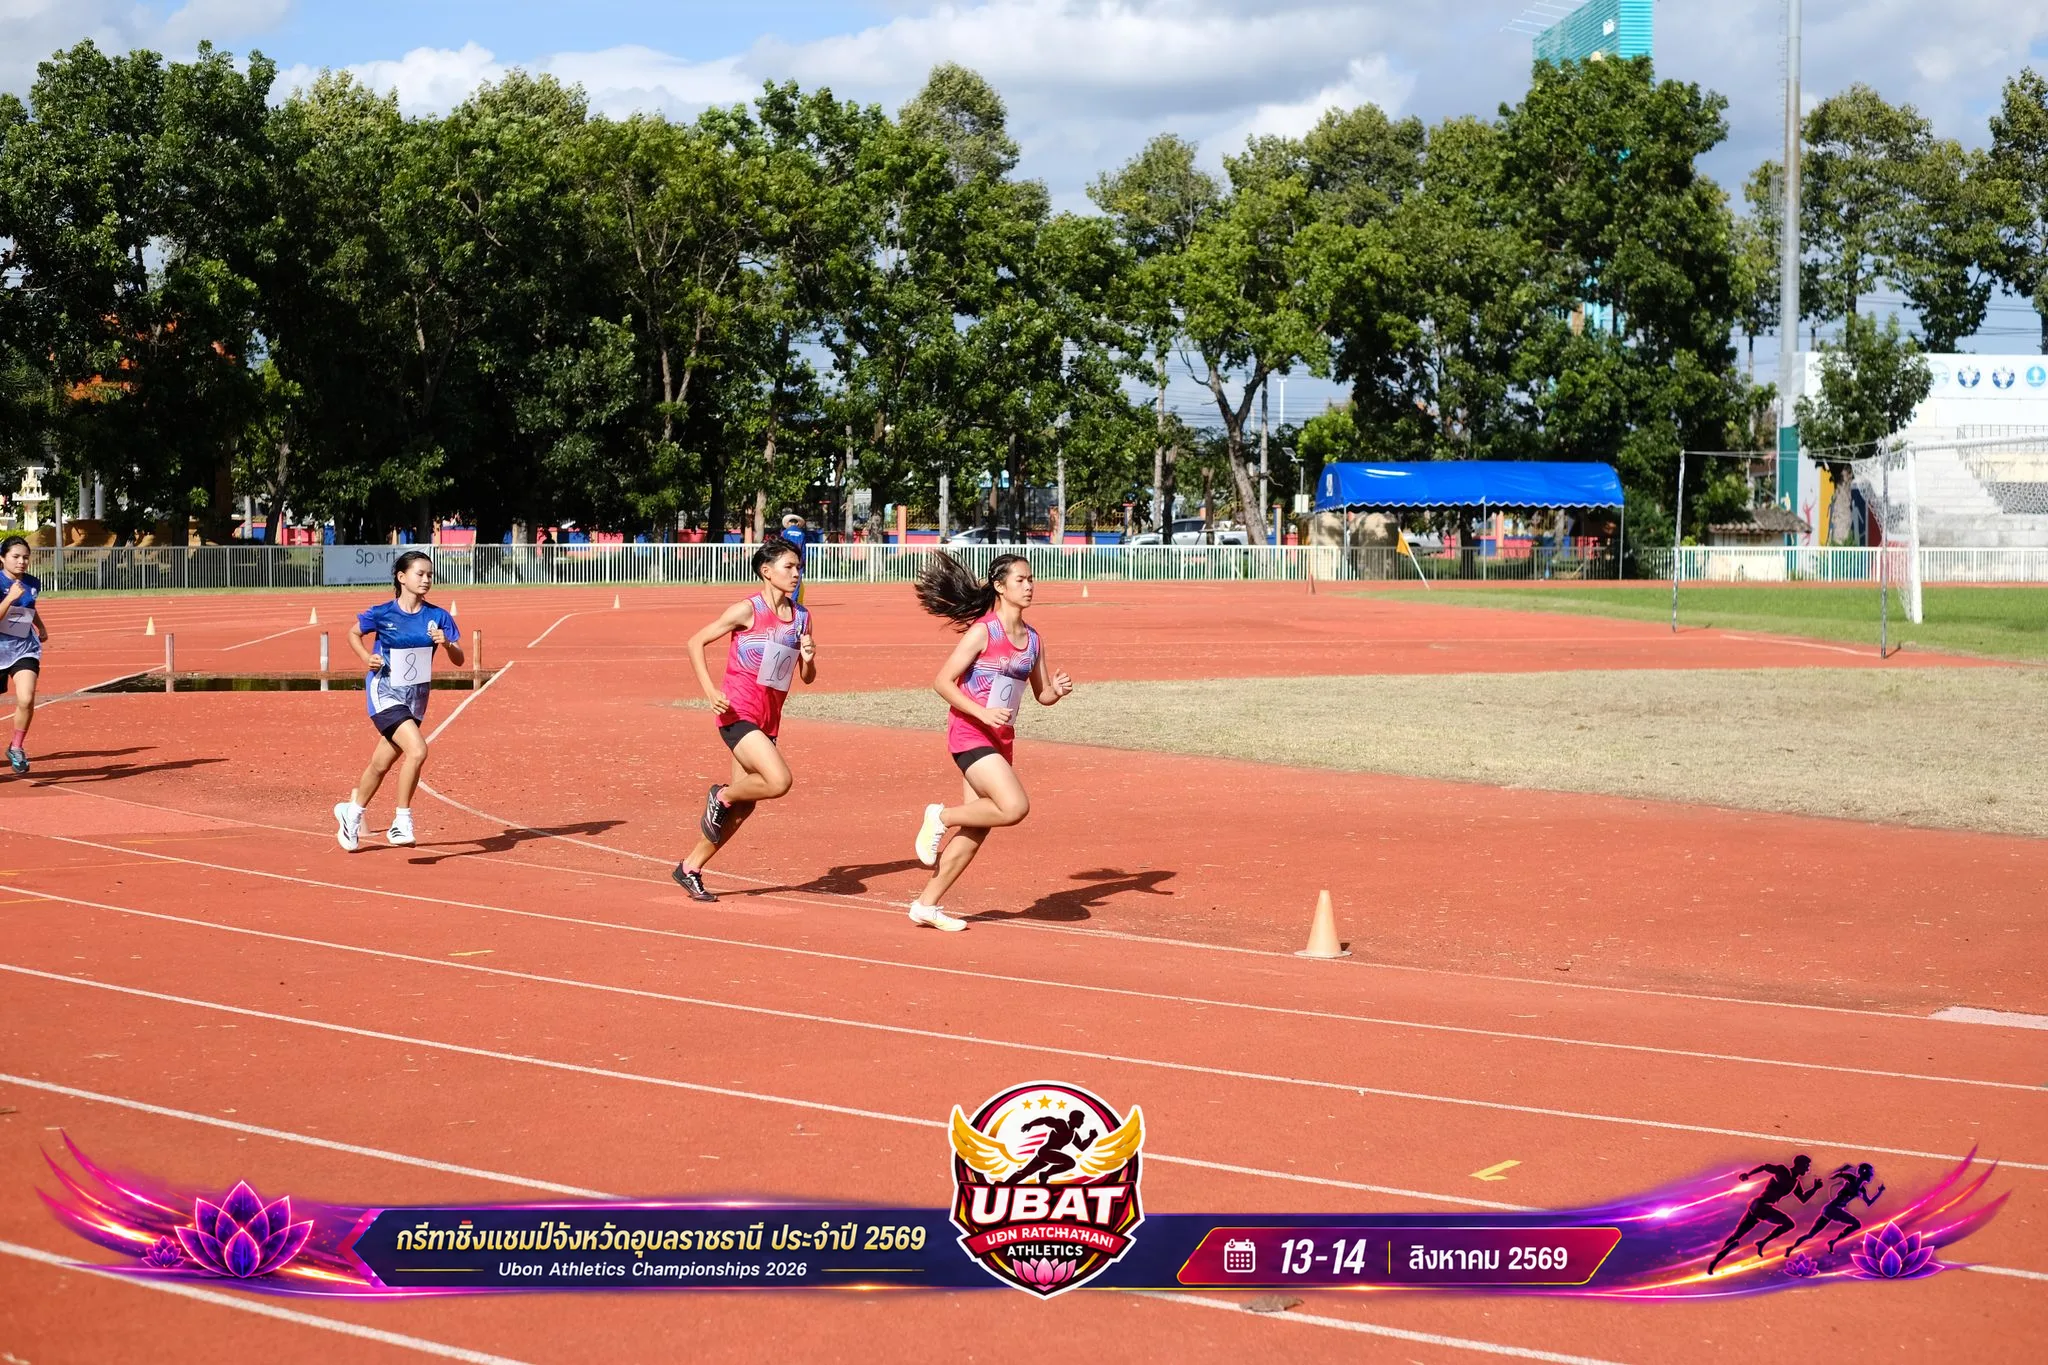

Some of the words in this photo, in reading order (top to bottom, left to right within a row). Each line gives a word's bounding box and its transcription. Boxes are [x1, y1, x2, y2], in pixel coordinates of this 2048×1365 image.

[8, 612, 24, 629] 7
[403, 652, 418, 682] 8
[765, 650, 792, 682] 10
[999, 683, 1013, 708] 9
